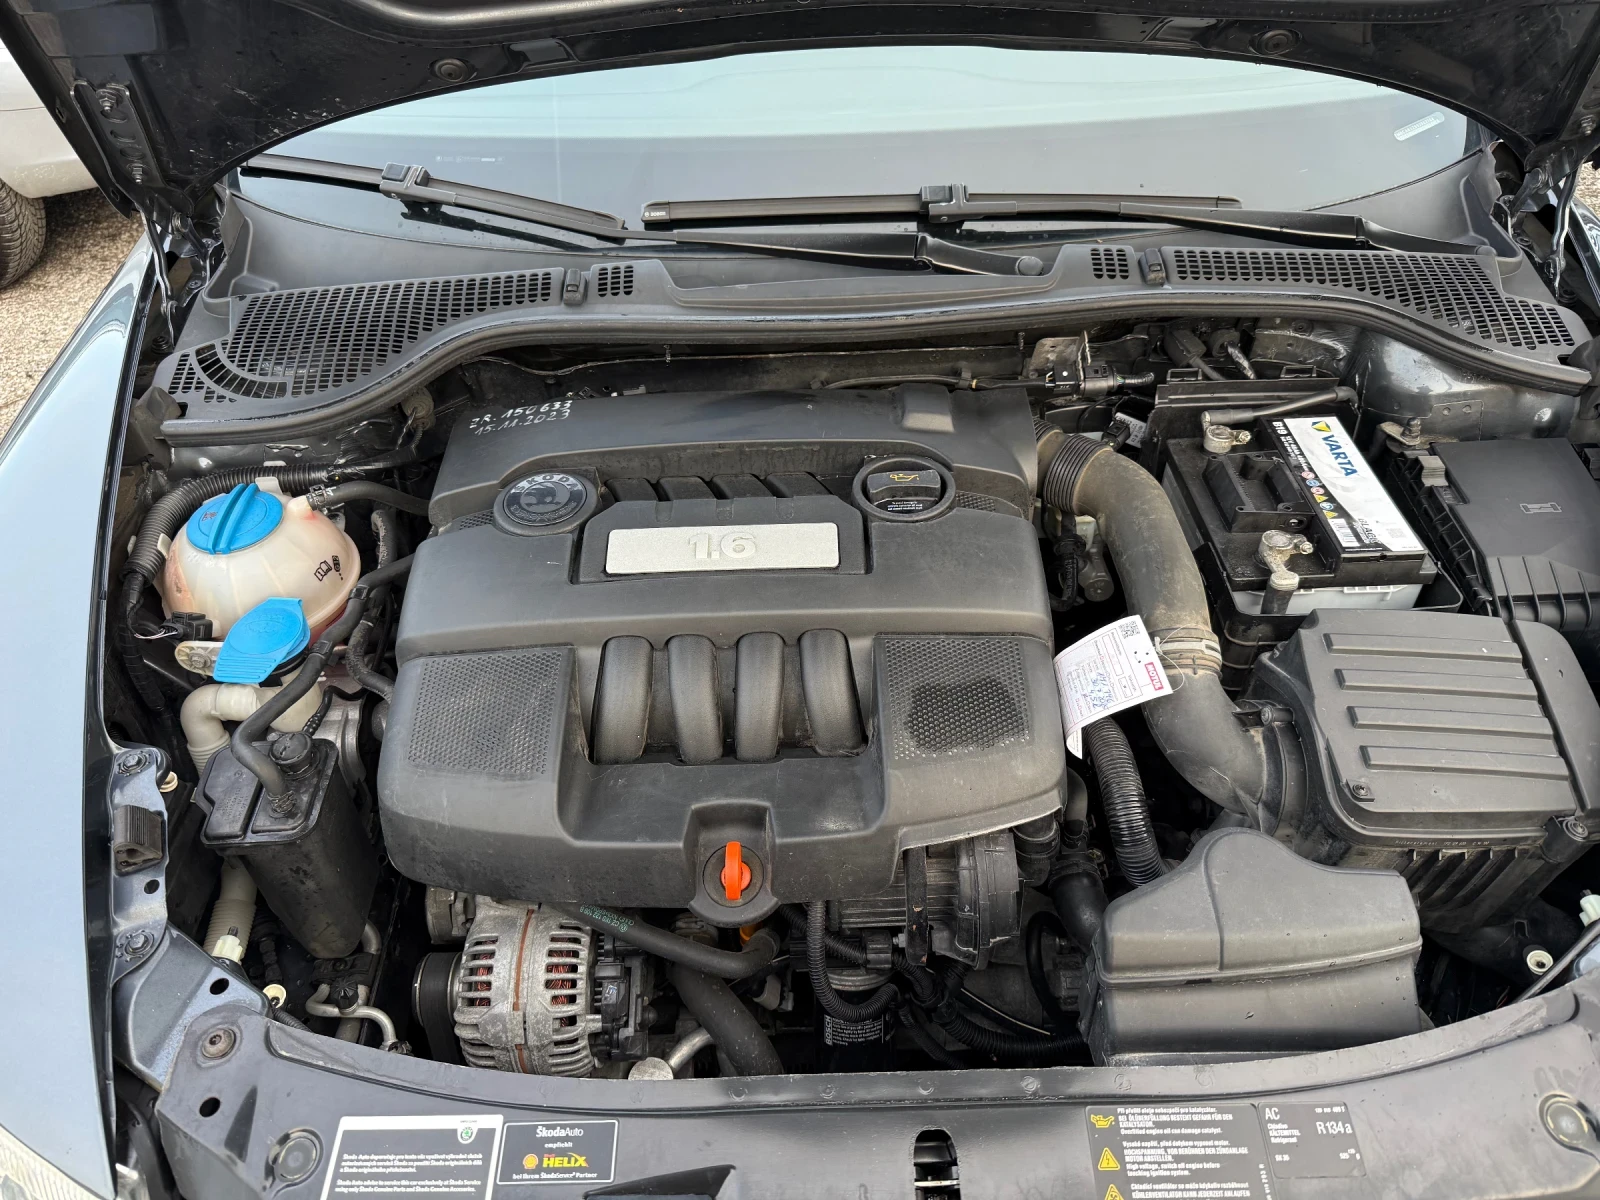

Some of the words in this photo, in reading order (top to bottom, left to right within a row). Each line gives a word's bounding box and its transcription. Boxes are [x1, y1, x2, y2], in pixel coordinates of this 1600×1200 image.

[475, 409, 570, 436] 15.11.2023
[1272, 421, 1288, 434] B19
[1322, 434, 1359, 476] VARTA
[688, 531, 756, 560] 1.6
[1146, 662, 1162, 690] MOTUL
[1265, 1108, 1280, 1120] AC
[536, 1126, 584, 1137] ŠkodaAuto
[542, 1154, 589, 1168] HELIX
